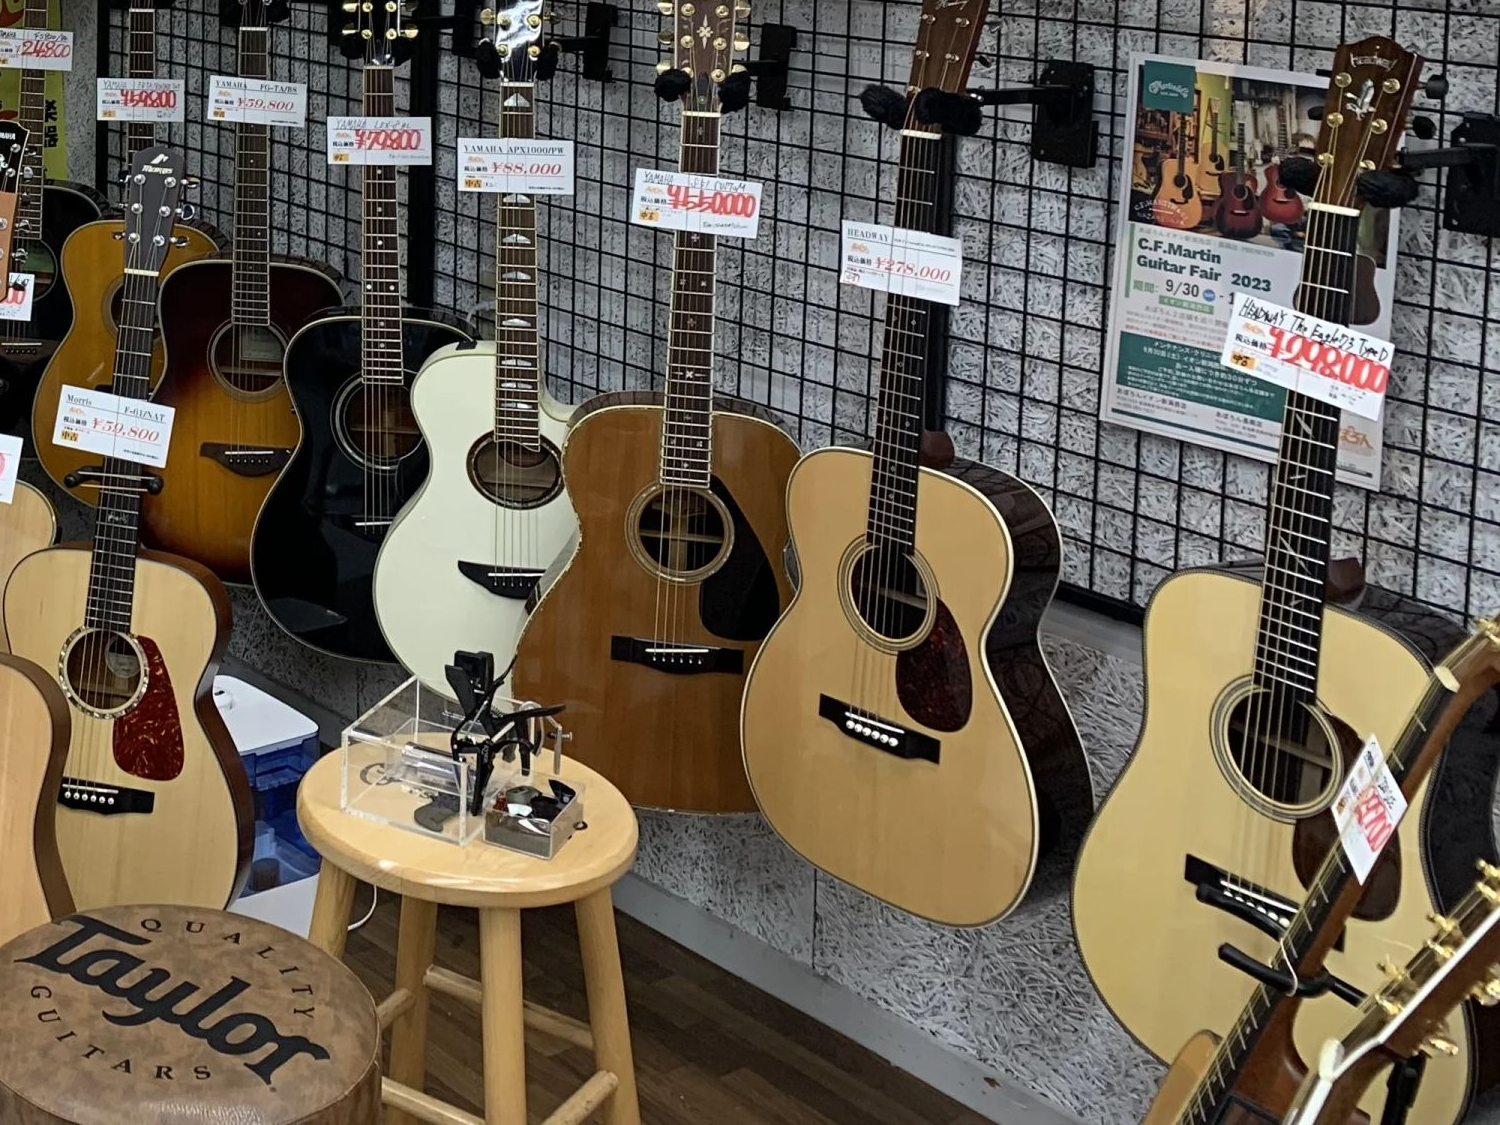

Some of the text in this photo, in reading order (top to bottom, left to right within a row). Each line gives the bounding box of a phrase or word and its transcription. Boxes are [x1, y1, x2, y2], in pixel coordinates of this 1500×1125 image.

[216, 80, 247, 89] YAMAHA
[464, 144, 504, 154] YAMAHA
[847, 228, 890, 243] HEADWAY
[1138, 237, 1222, 265] C.F.Martin
[1136, 255, 1272, 293] Guitar Fair 2023
[1165, 279, 1200, 298] 9/30
[1292, 315, 1310, 334] The
[1235, 332, 1268, 351] 税込価格
[66, 393, 93, 408] Morris
[62, 416, 88, 427] 税込価格
[140, 917, 316, 1020] QUALITY
[13, 913, 331, 1087] Taylor
[30, 984, 212, 1081] GUITARS
